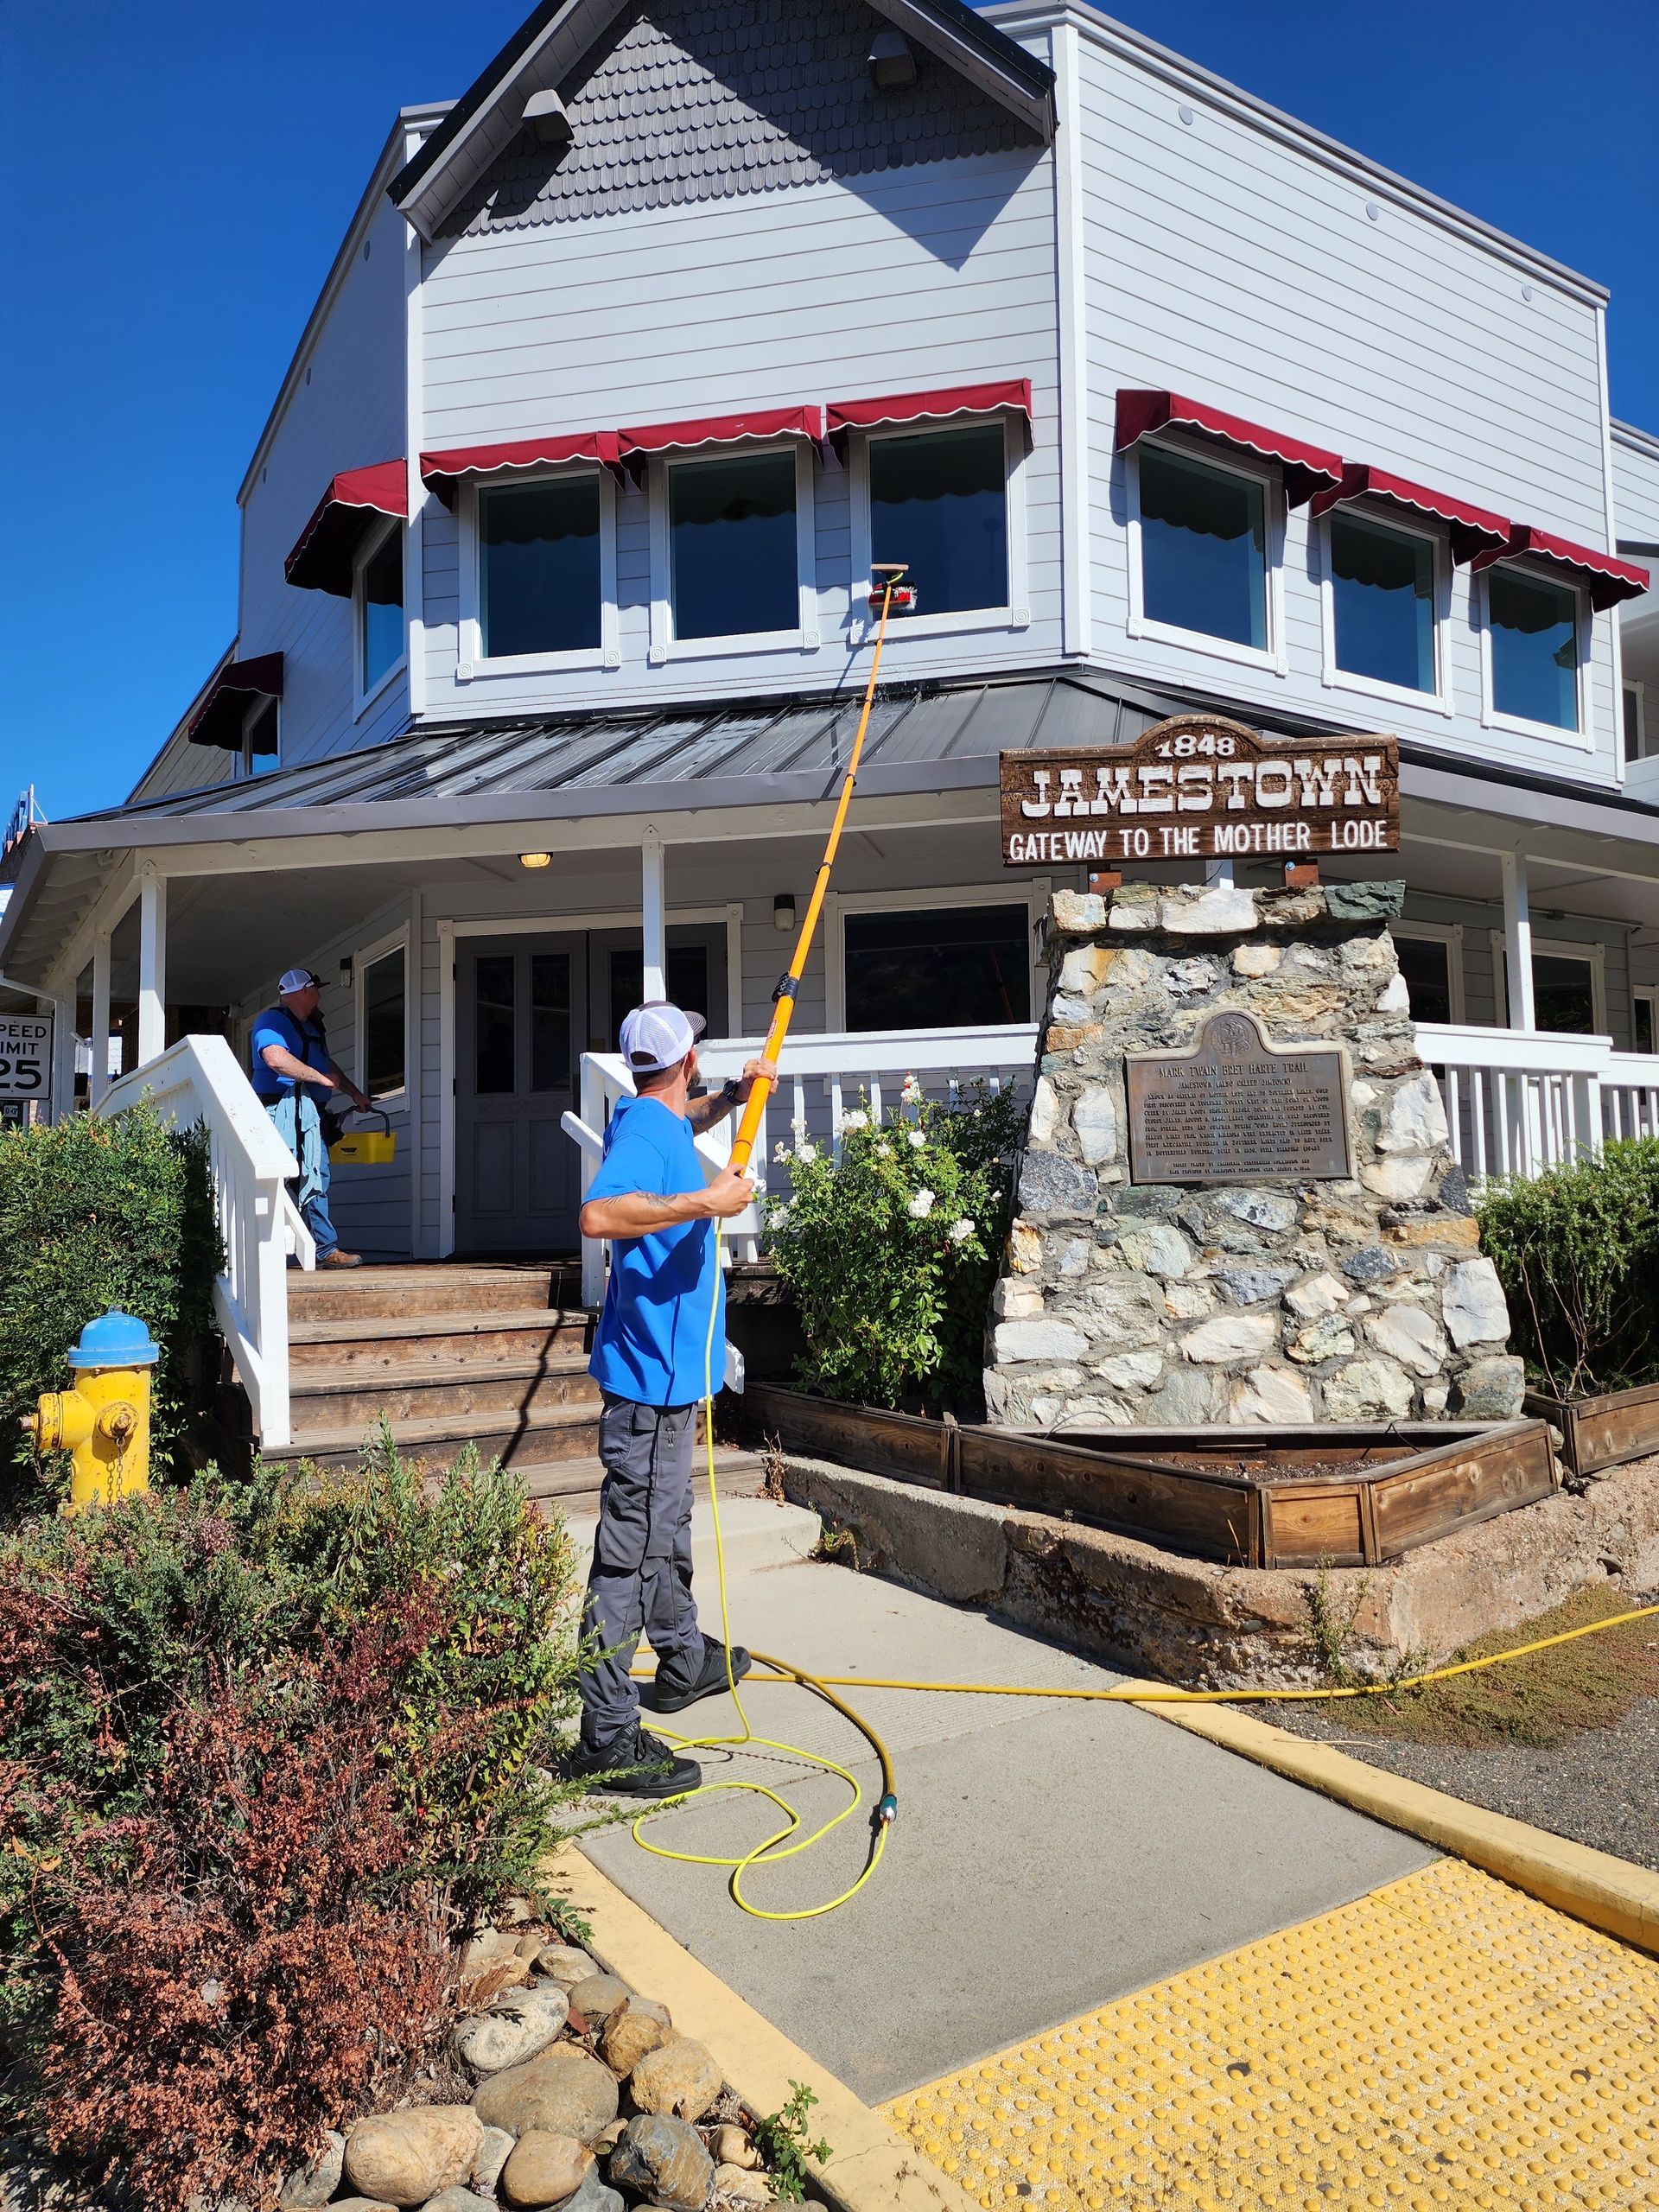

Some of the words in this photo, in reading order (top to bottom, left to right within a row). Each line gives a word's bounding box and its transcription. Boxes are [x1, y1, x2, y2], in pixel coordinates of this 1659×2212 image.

[1155, 734, 1236, 759] 1848
[1021, 756, 1381, 817] JAMESTOWN
[1009, 830, 1107, 861] GATEWAY
[1119, 828, 1150, 856] TO
[1159, 826, 1200, 855] THE
[1214, 822, 1311, 853] MOTHER
[1332, 820, 1388, 849] LODE
[1159, 1066, 1185, 1077] MARK
[1189, 1065, 1217, 1077] TWAIN
[1222, 1064, 1244, 1076] BRET
[1249, 1063, 1277, 1075] HARTE
[1282, 1062, 1309, 1073] TRAIL
[625, 1720, 639, 1735] DVS
